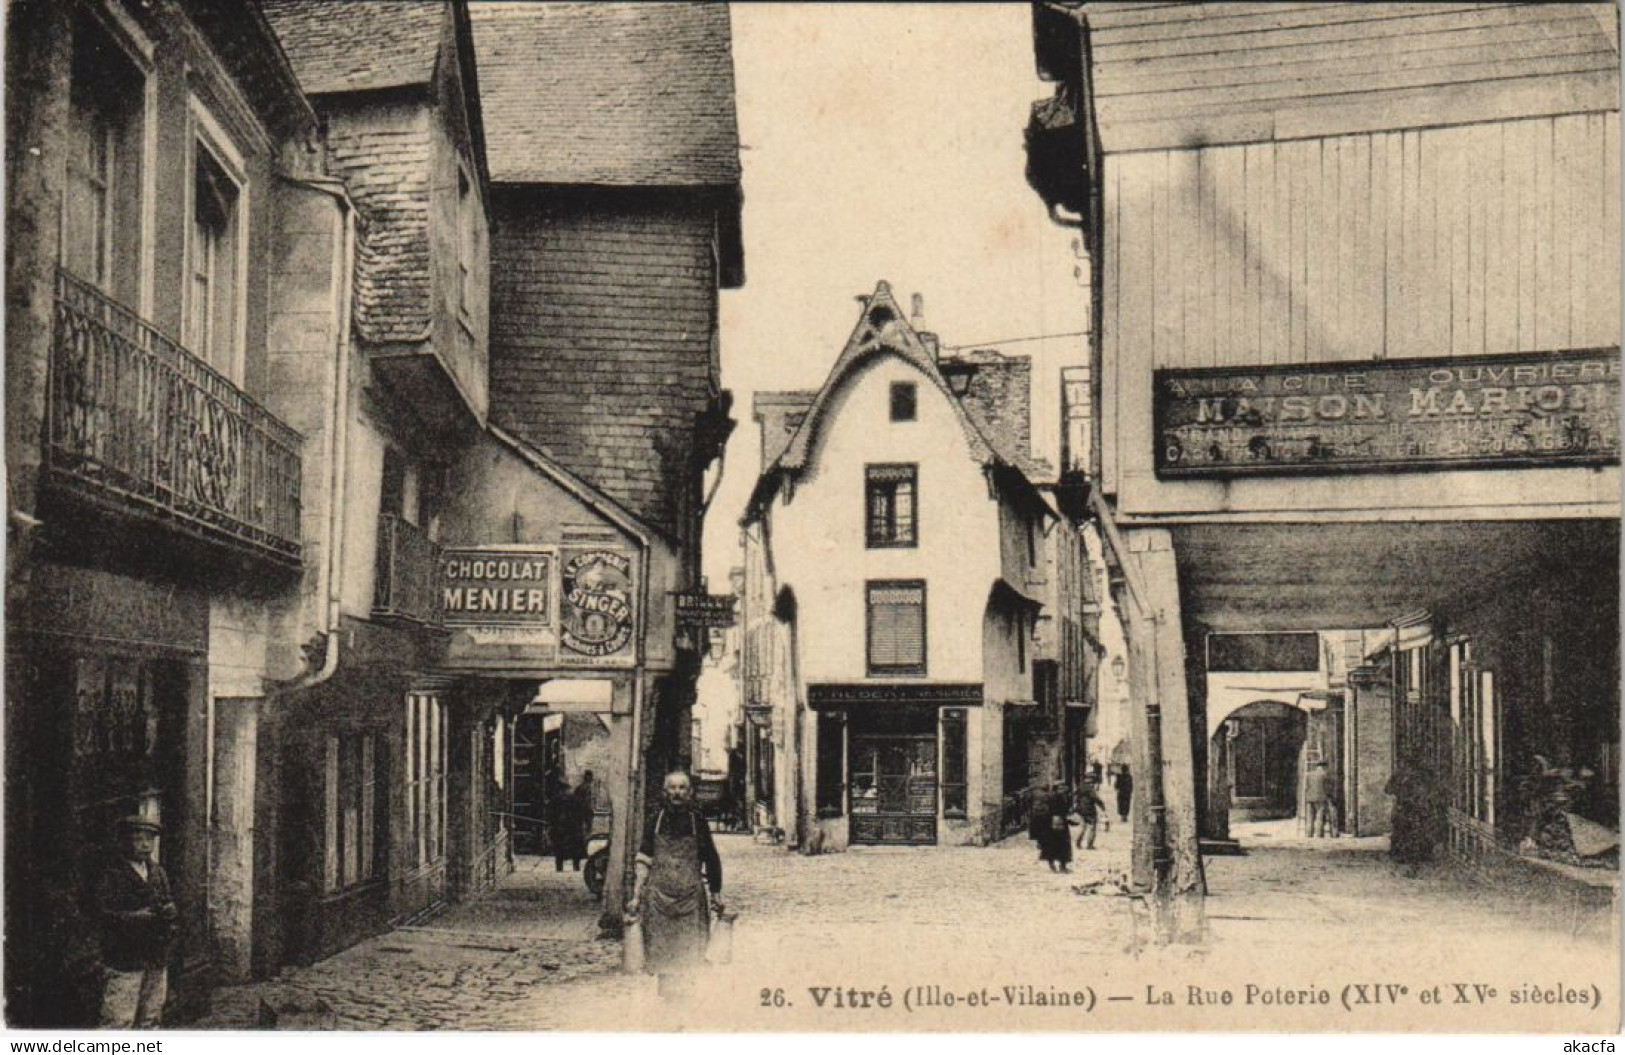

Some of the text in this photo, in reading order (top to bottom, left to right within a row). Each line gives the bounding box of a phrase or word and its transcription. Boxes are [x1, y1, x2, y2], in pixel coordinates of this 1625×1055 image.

[1212, 377, 1259, 392] LA
[1196, 382, 1610, 423] MAISON MARION
[447, 559, 546, 580] CHOCOLAT
[443, 587, 545, 612] MENIER
[568, 588, 629, 622] SINGER
